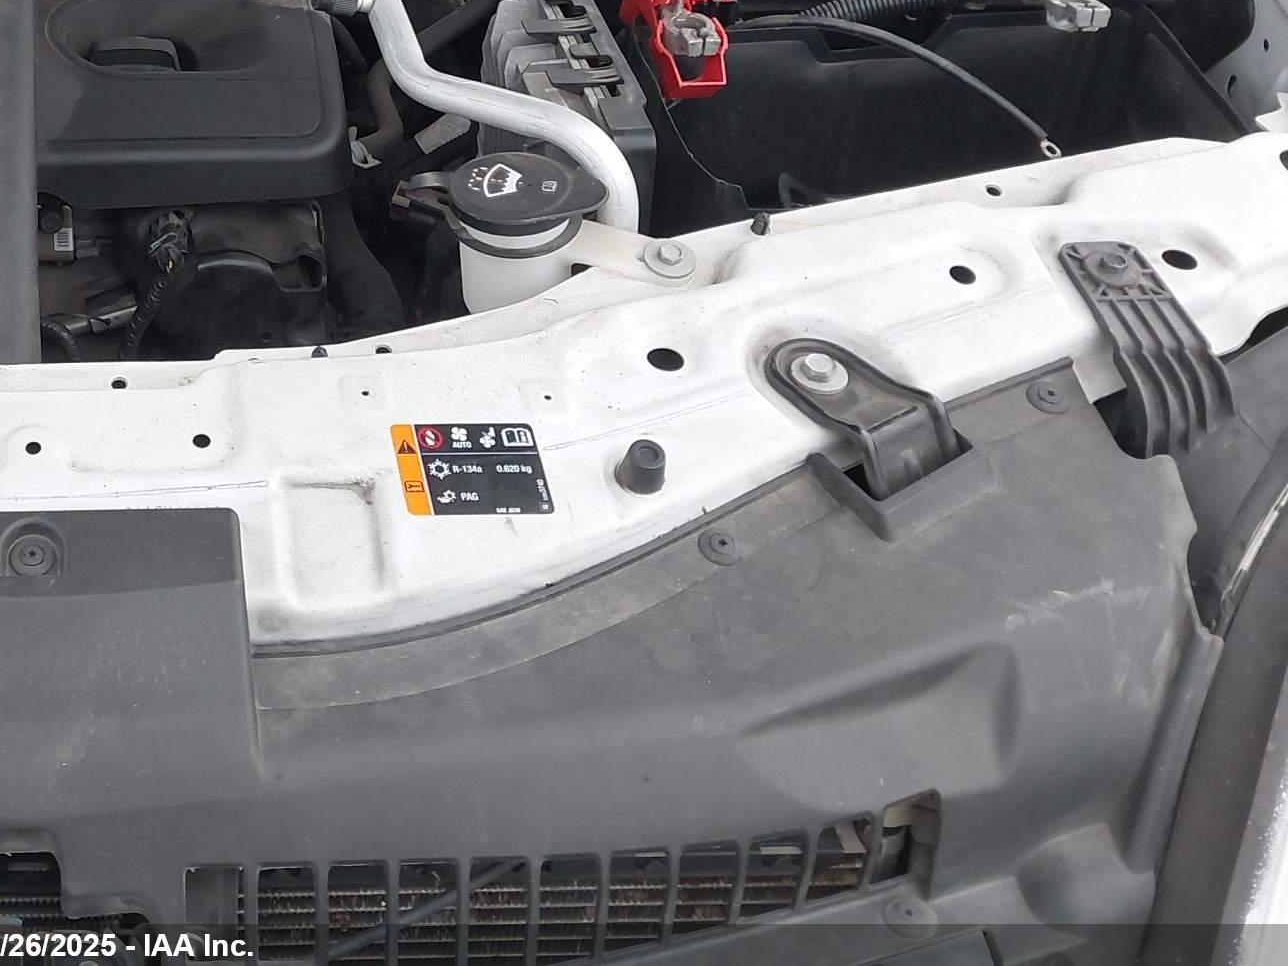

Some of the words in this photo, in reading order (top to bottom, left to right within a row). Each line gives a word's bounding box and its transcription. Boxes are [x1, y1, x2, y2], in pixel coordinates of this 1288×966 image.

[452, 441, 472, 449] AUTO
[452, 465, 483, 474] R-134a
[520, 464, 533, 475] kg
[460, 492, 479, 501] PAG
